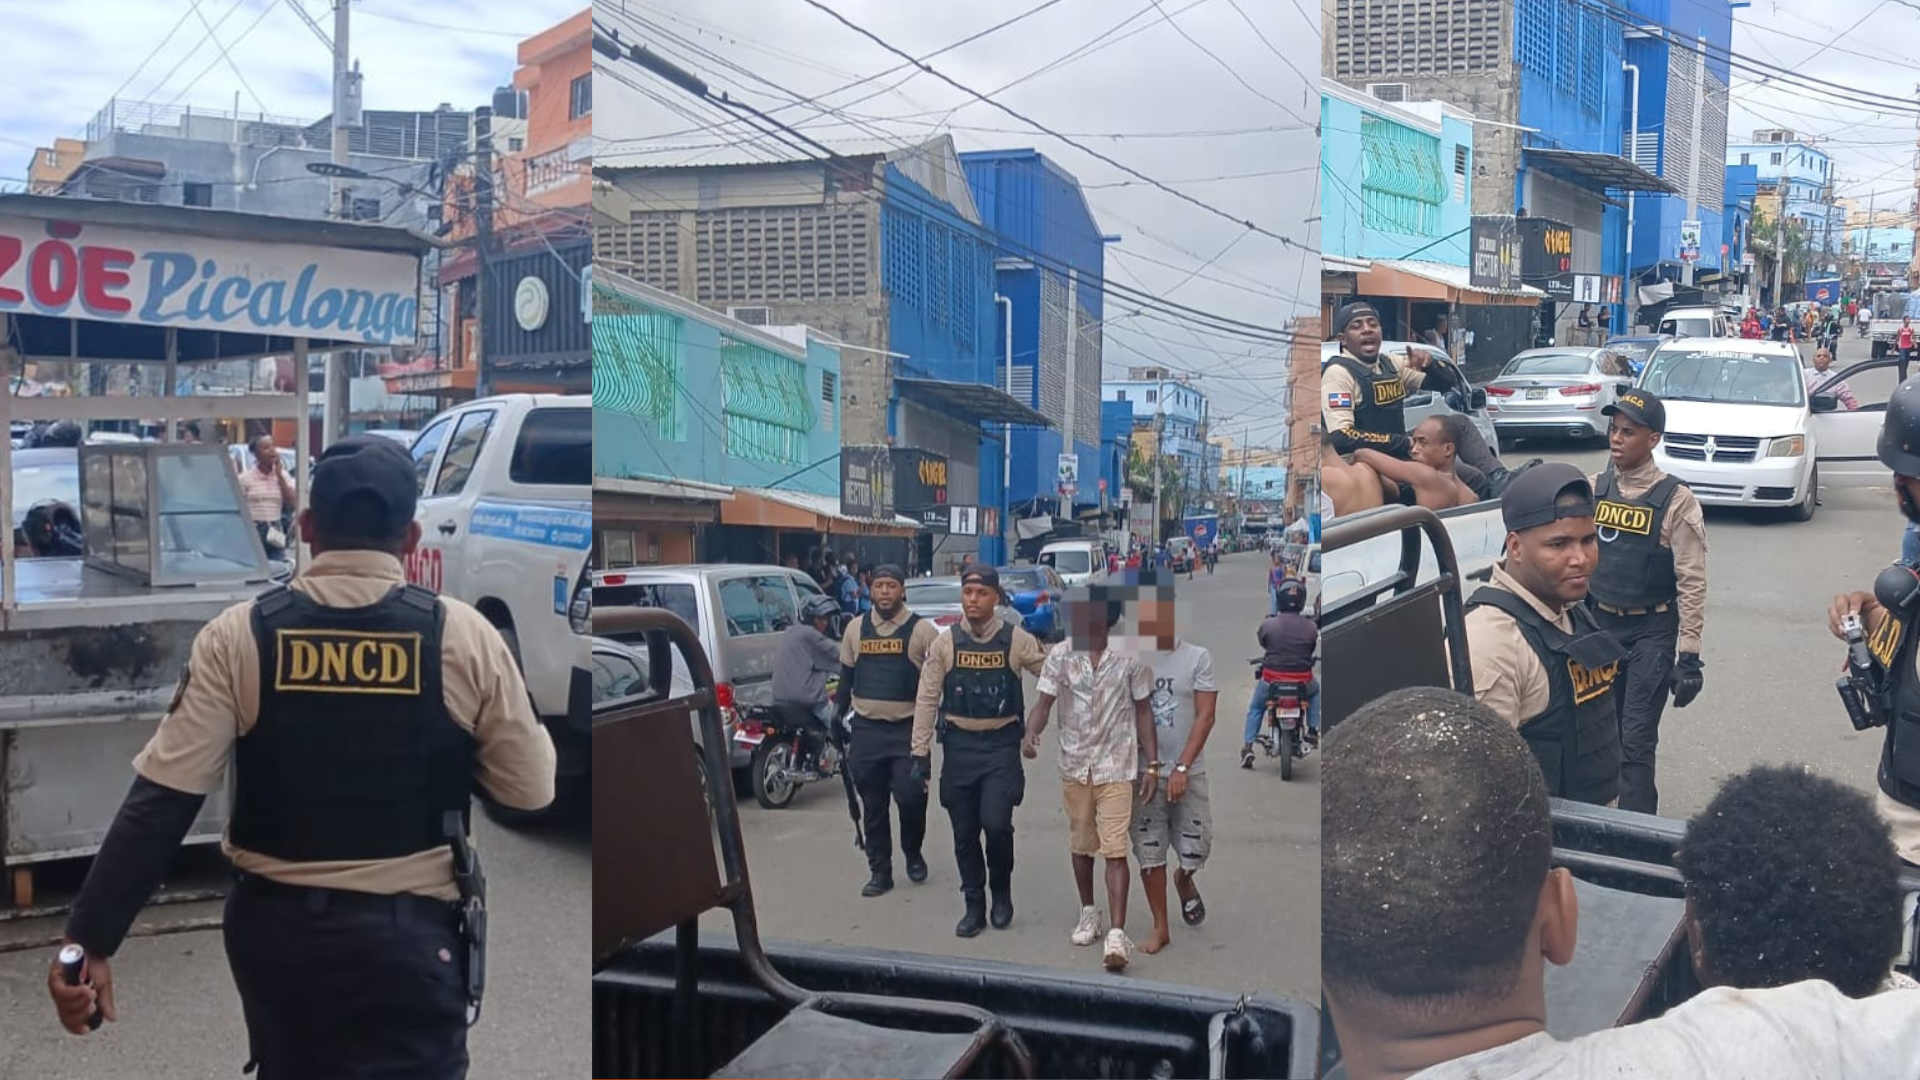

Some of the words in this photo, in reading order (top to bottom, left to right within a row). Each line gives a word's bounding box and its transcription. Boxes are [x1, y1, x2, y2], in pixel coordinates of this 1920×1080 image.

[1597, 504, 1646, 528] DNCD
[860, 640, 899, 652] DNCD
[289, 640, 408, 682] DNCD
[961, 653, 1001, 666] DNCD
